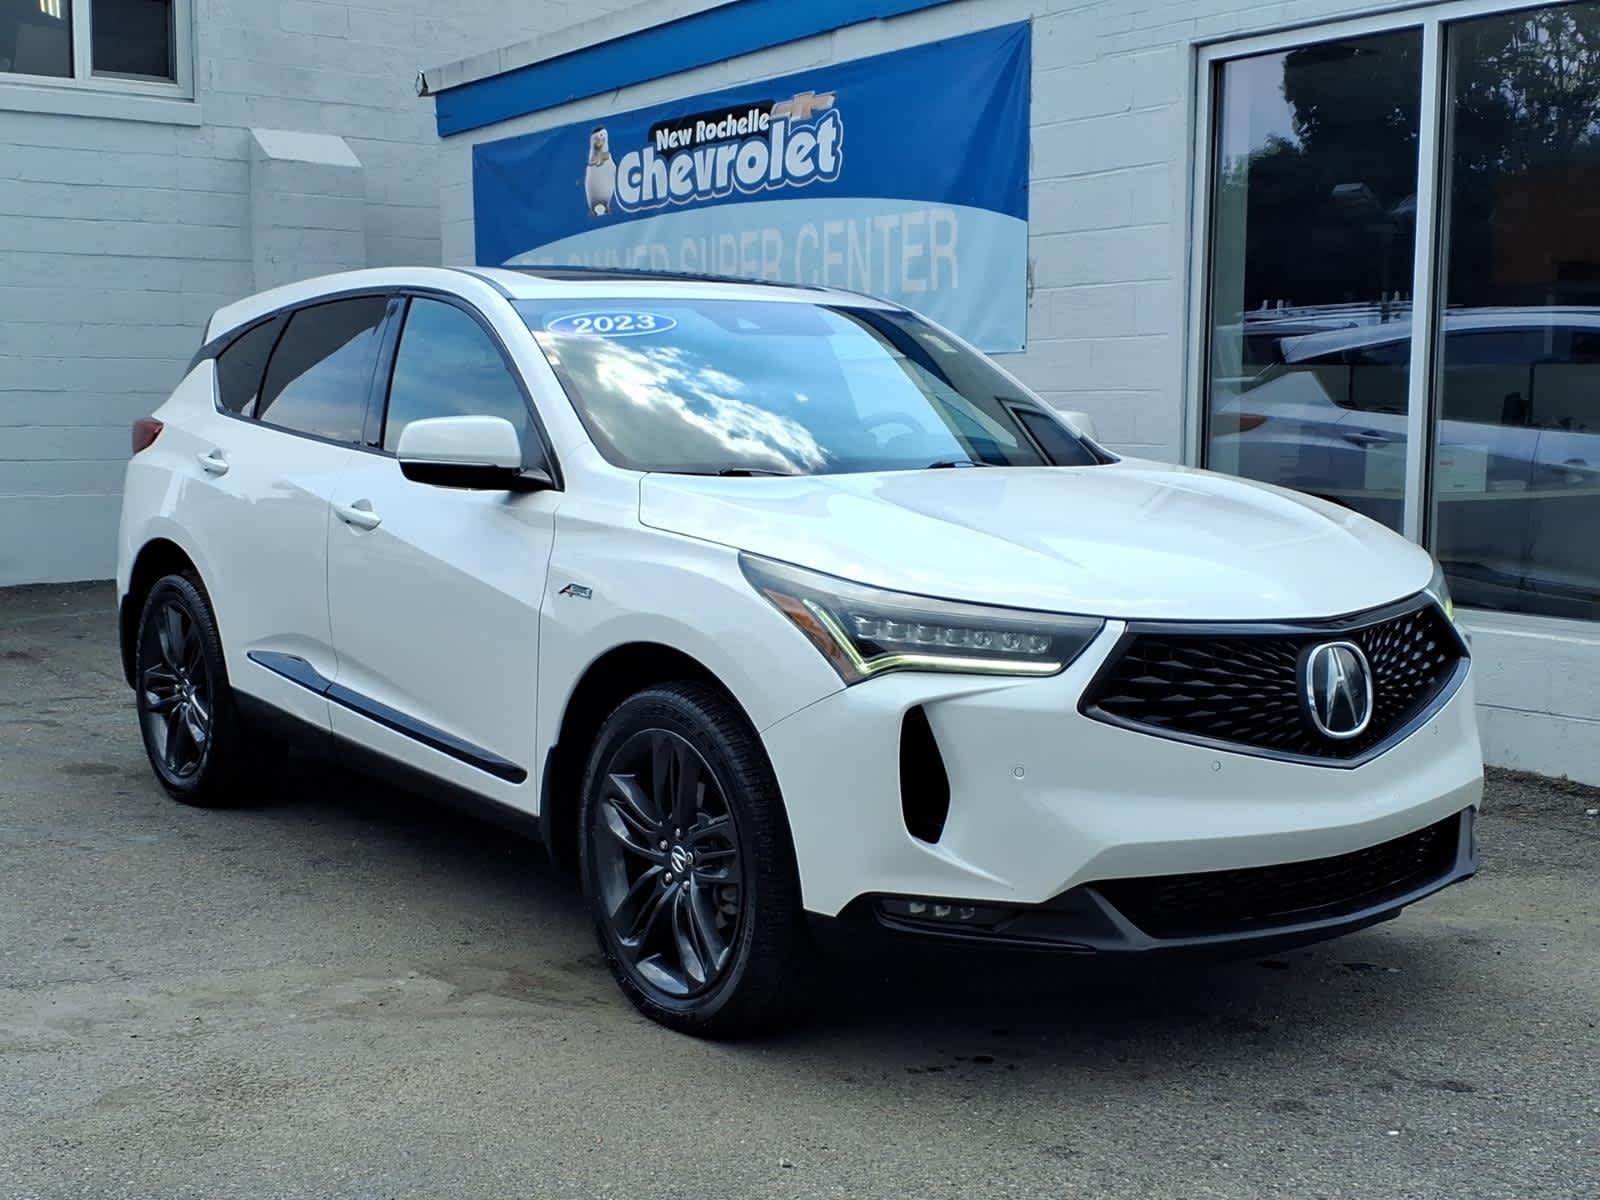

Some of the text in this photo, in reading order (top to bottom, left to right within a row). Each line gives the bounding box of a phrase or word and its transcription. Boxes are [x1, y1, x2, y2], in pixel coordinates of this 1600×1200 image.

[616, 116, 838, 204] Chevrolet
[655, 108, 770, 151] New Rochelle
[795, 206, 959, 295] CENTER
[571, 314, 657, 334] 2023
